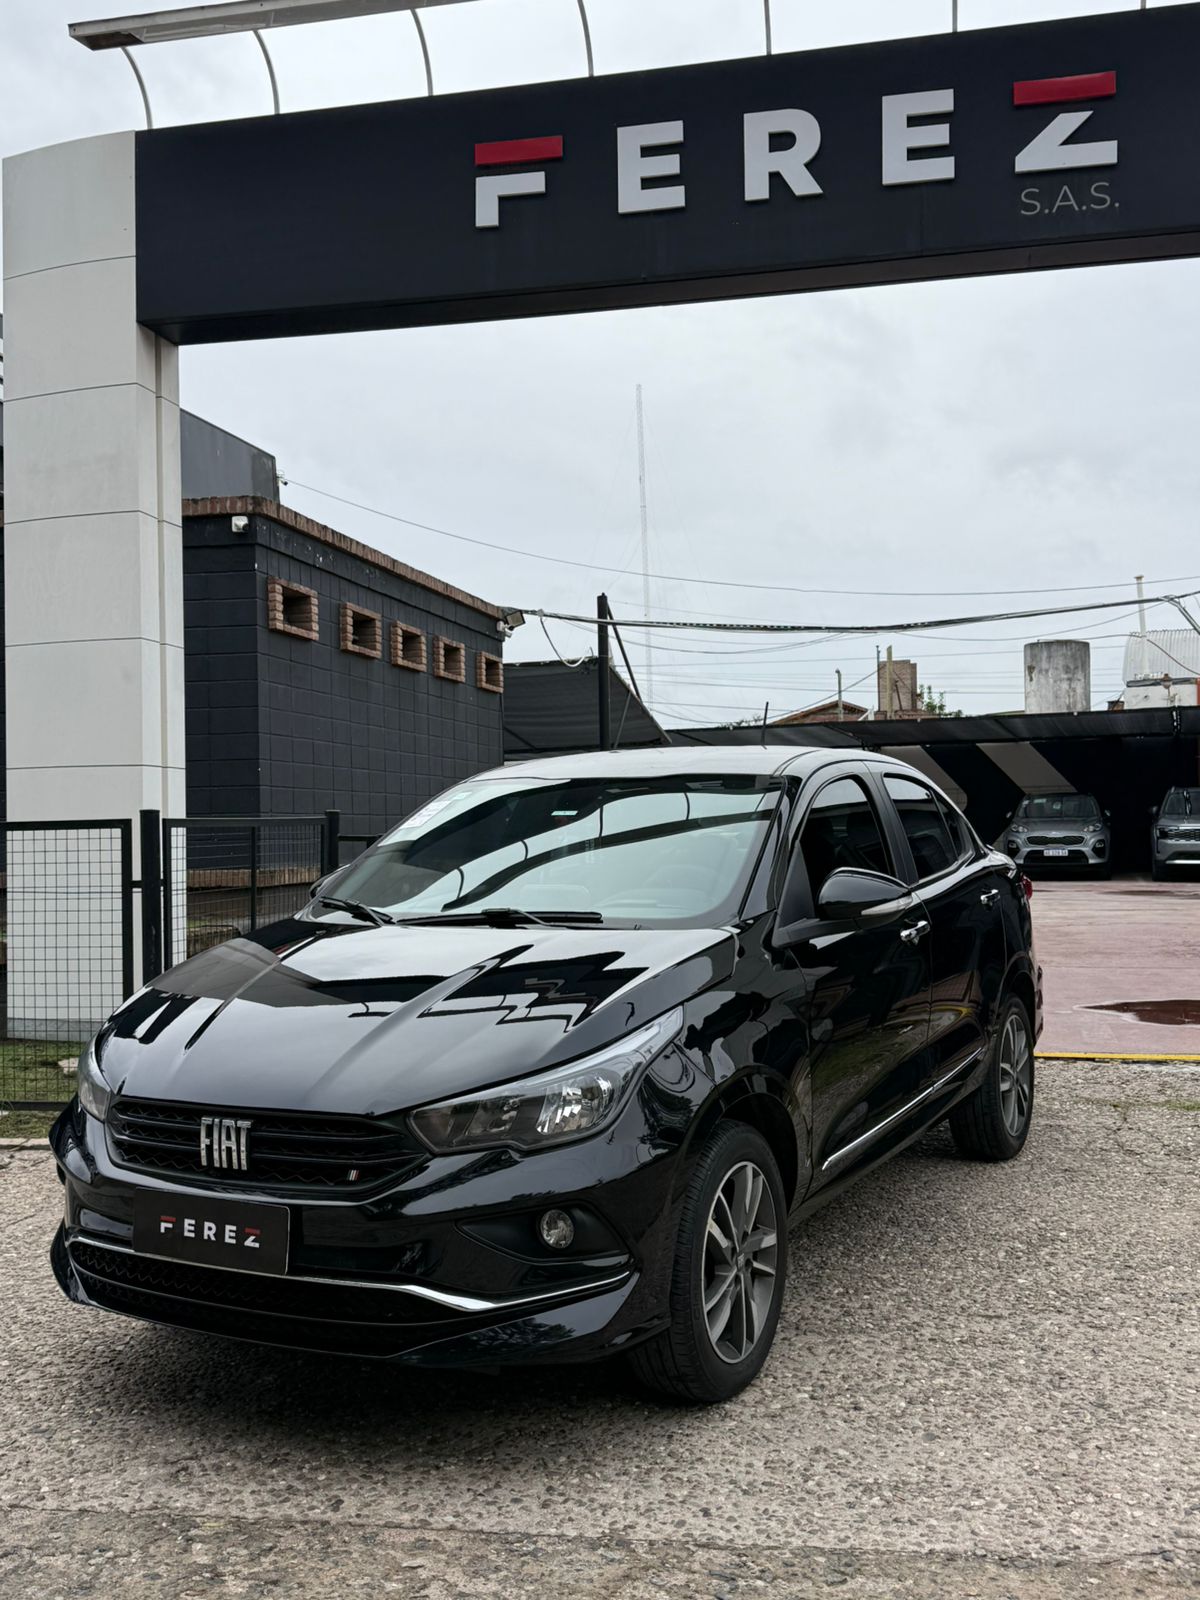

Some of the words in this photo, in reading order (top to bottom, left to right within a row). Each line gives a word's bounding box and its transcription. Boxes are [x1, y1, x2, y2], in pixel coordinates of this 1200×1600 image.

[474, 70, 1119, 228] FEREZ
[1021, 182, 1120, 215] S.A.S.
[200, 1116, 252, 1171] FIAT
[159, 1215, 261, 1249] FEREZ
